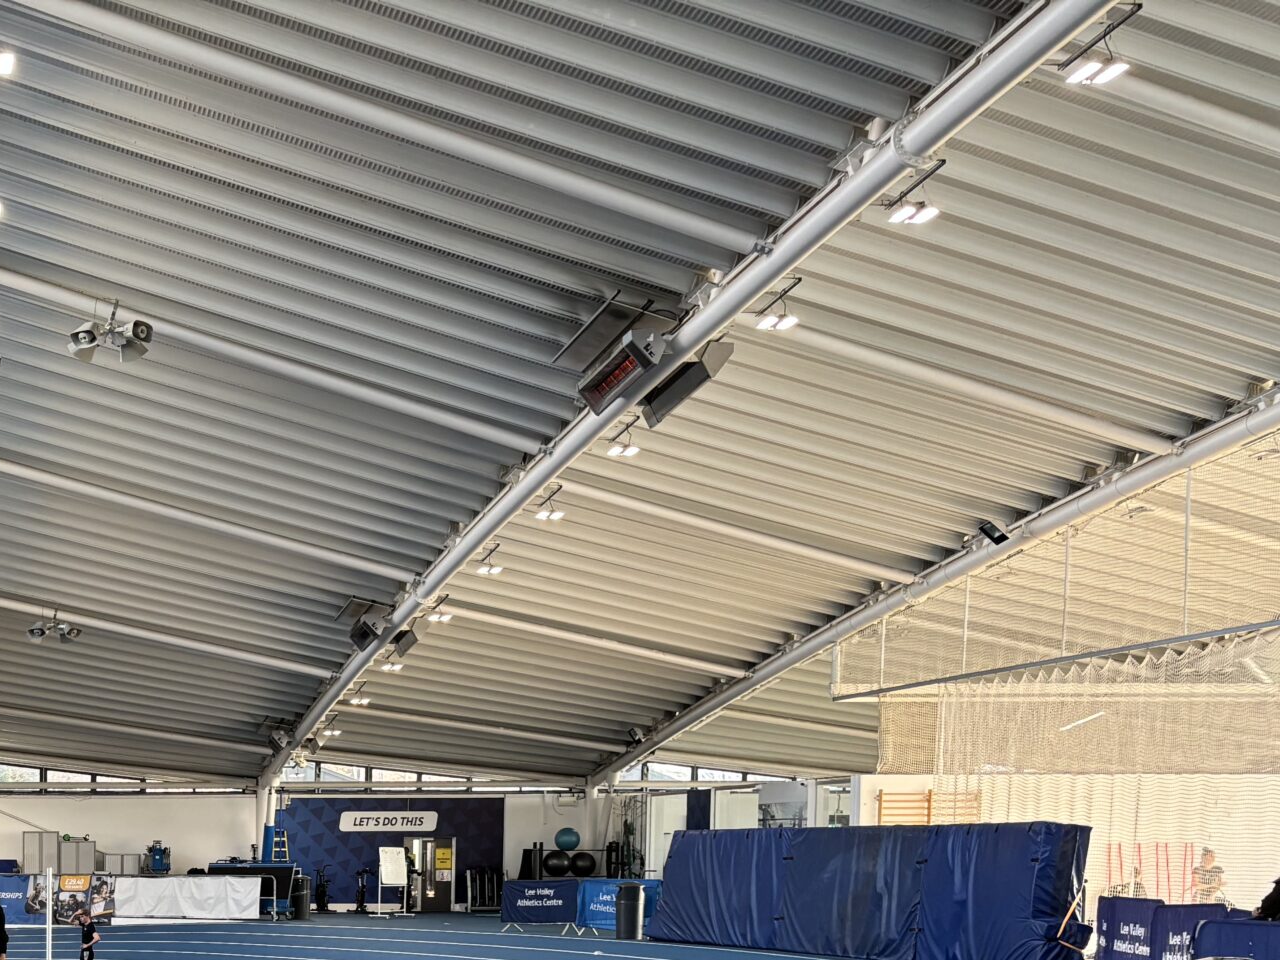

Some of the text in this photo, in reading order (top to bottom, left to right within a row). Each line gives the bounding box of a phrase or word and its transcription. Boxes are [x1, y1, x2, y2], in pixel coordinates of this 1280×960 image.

[353, 816, 424, 827] LET'S DO THIS
[525, 888, 555, 897] Lee Valley
[599, 893, 612, 901] Lee
[517, 898, 563, 907] Athletics Centre
[1120, 922, 1145, 940] Lee Valley
[1169, 932, 1181, 945] Lee
